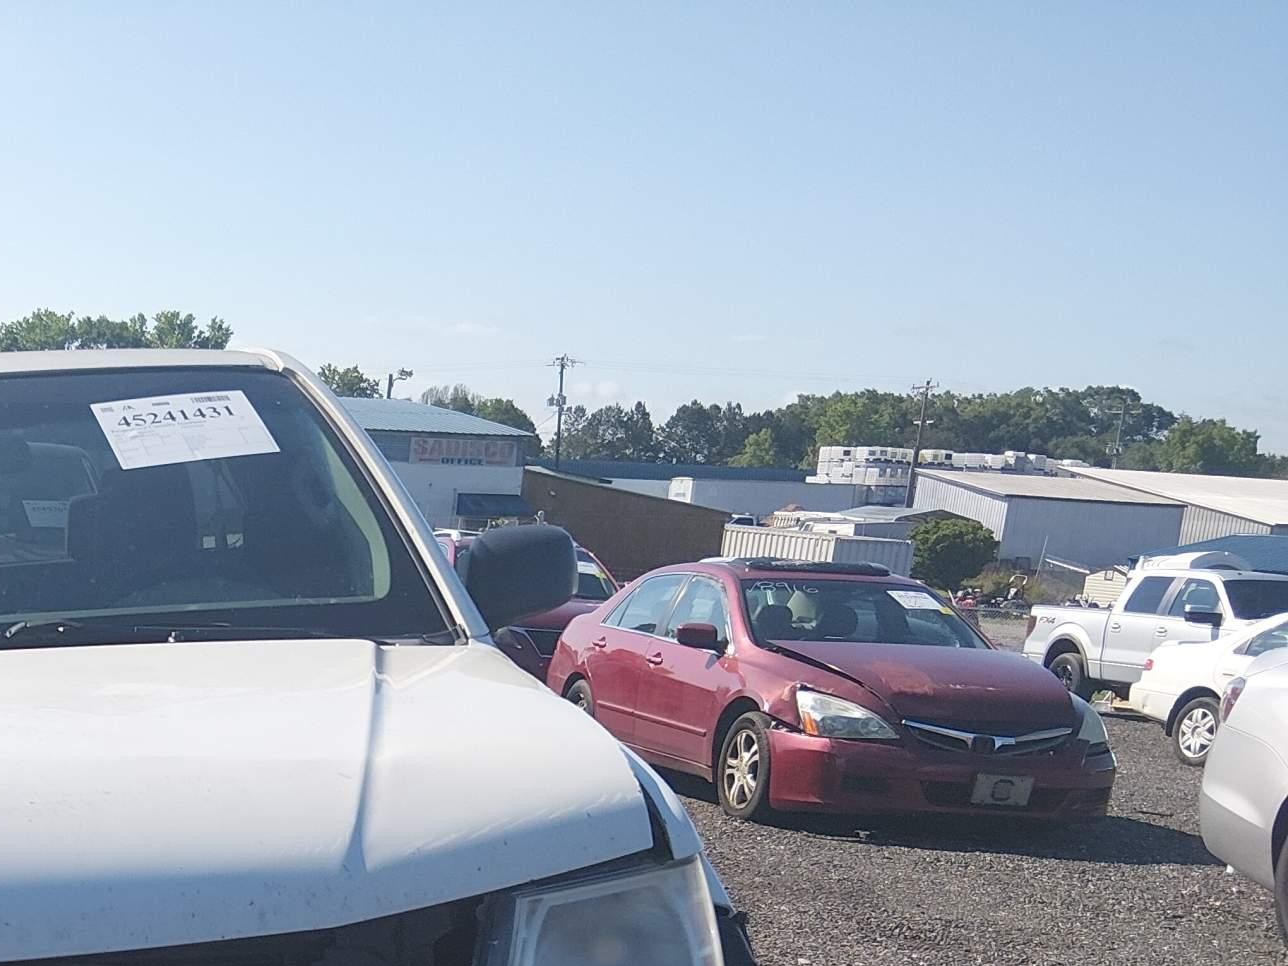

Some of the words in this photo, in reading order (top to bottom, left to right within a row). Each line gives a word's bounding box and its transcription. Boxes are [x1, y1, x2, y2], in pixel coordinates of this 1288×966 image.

[117, 405, 235, 428] 45241431
[441, 457, 484, 466] OFFICE
[1039, 616, 1056, 624] FX4
